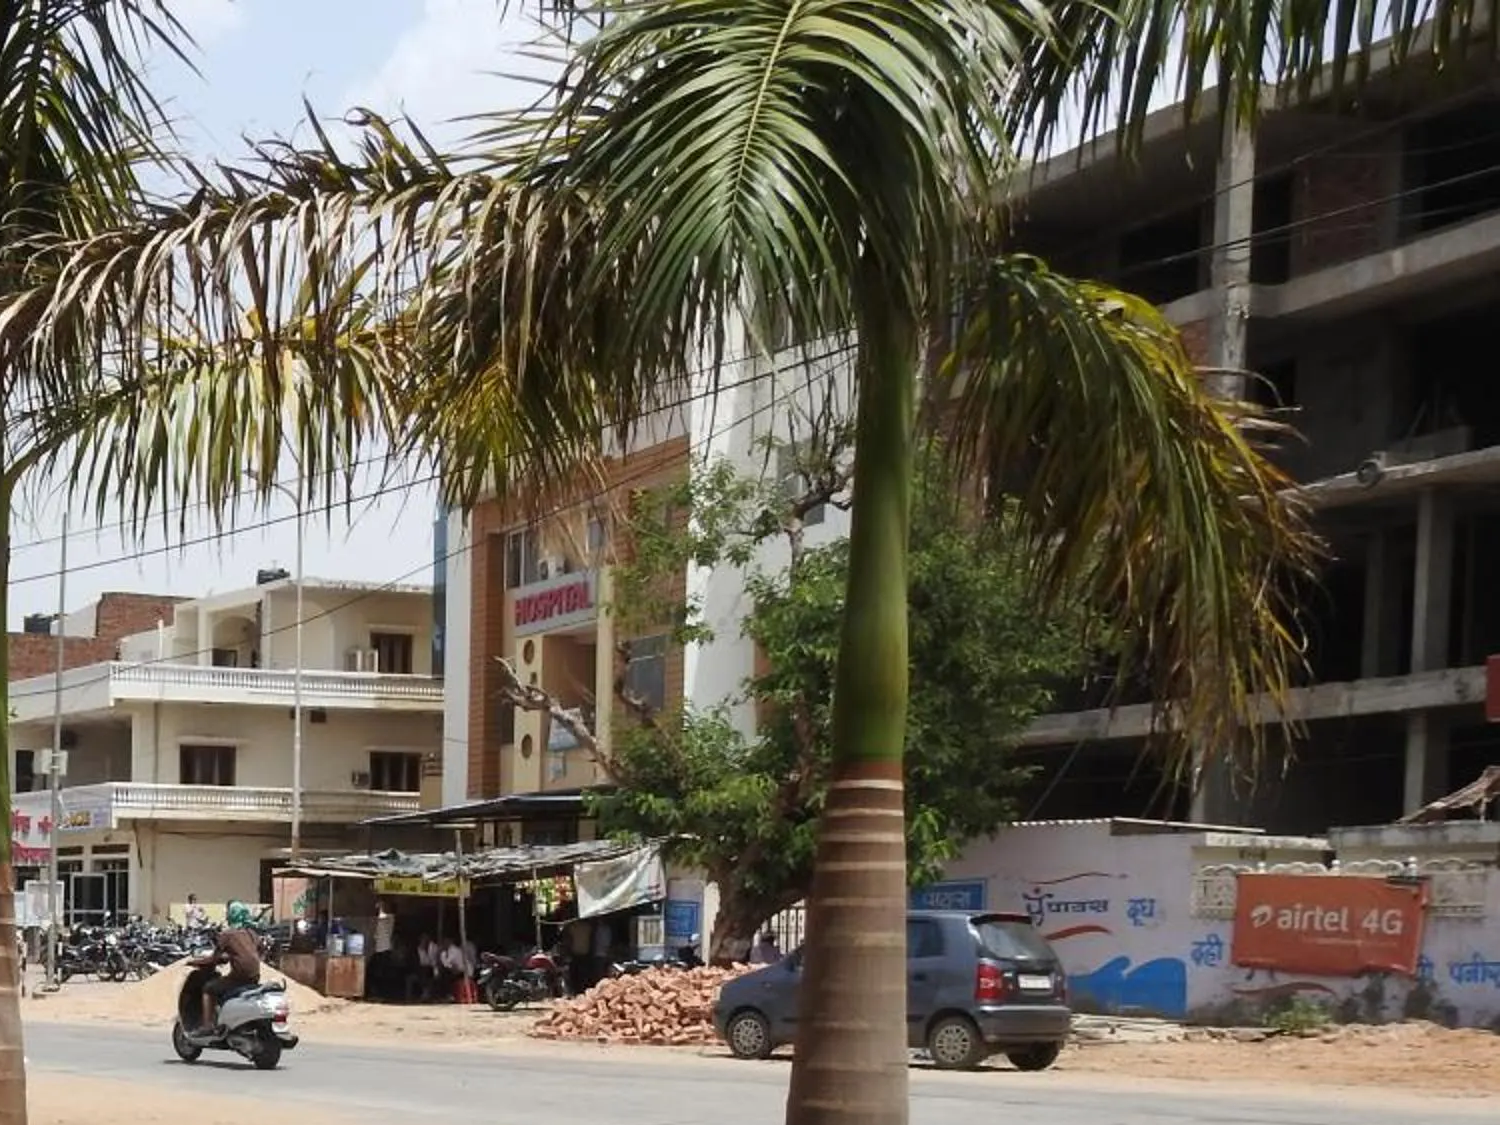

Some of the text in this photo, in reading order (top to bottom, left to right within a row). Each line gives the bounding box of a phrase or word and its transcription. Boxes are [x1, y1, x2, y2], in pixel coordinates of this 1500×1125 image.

[515, 581, 593, 627] HOSPITAL
[1126, 896, 1156, 927] दूध
[1276, 902, 1403, 934] airtel 4G
[1190, 933, 1224, 967] दही
